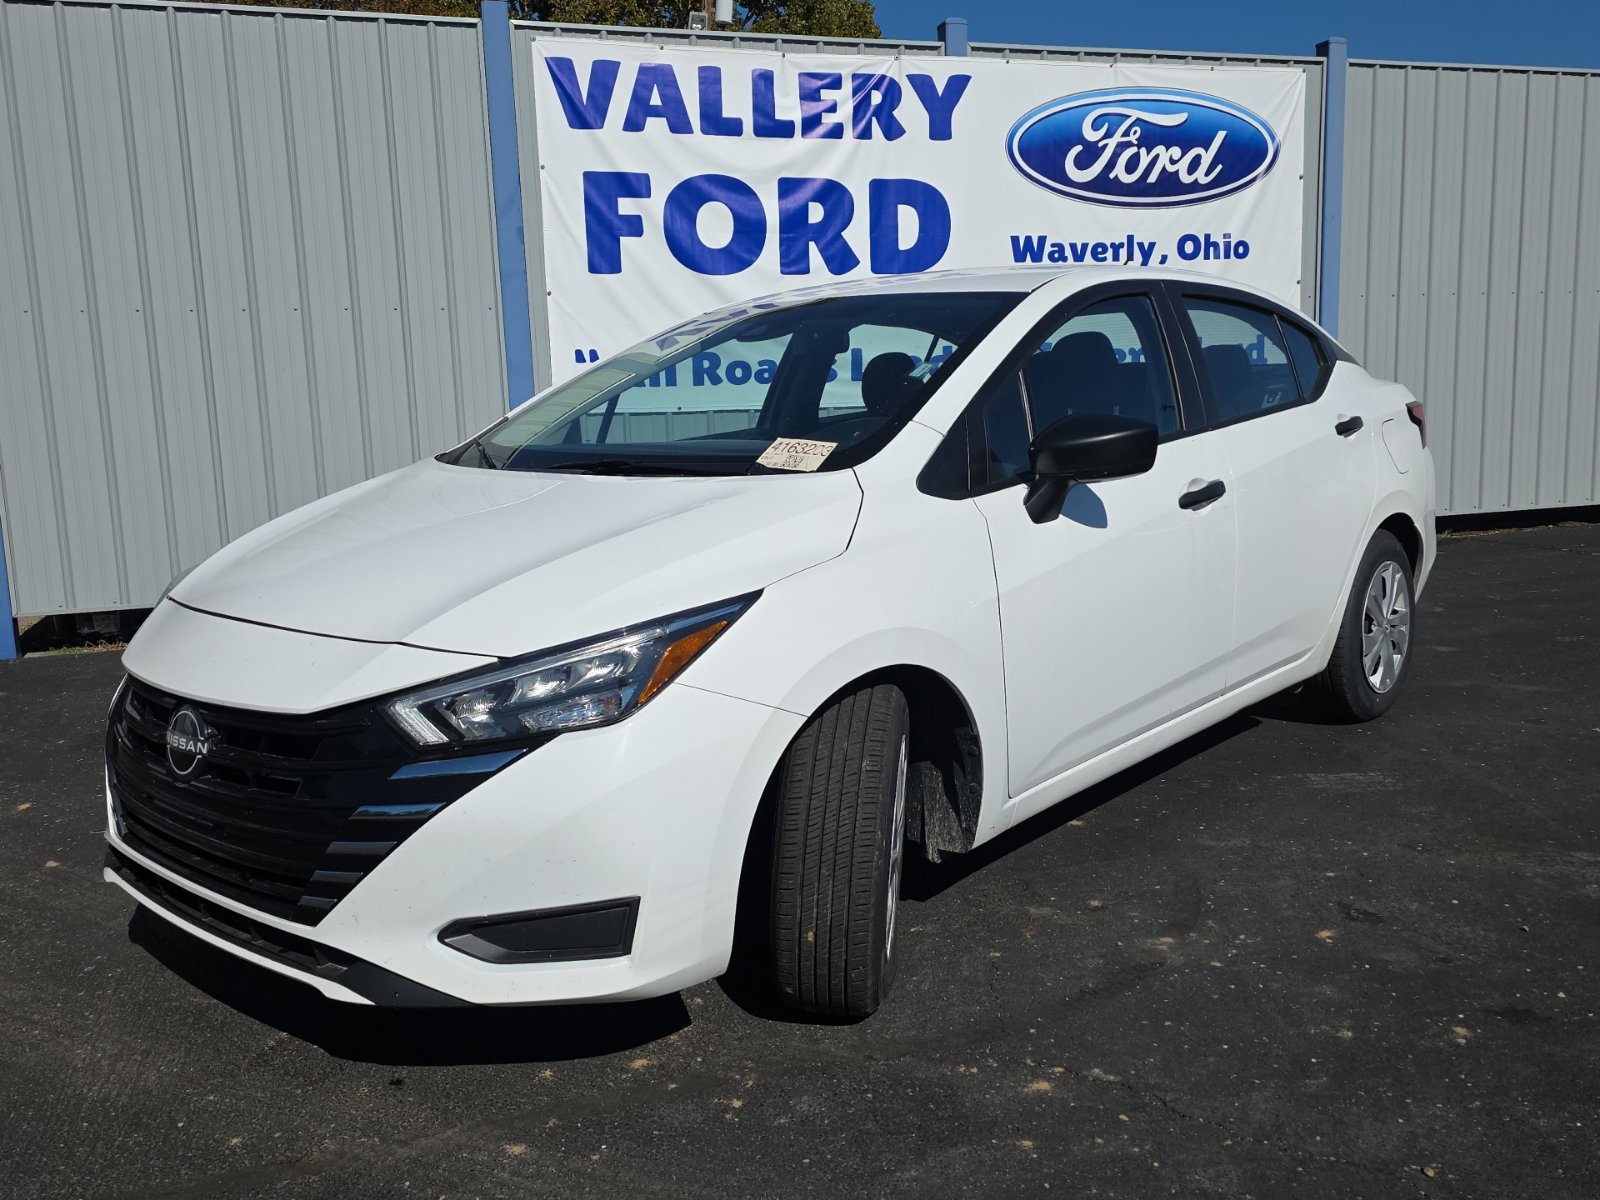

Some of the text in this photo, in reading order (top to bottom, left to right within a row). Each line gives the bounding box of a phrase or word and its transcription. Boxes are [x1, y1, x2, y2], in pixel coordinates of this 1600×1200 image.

[545, 56, 972, 142] VALLERY
[1065, 106, 1228, 185] Ford
[583, 170, 952, 276] FORD
[1010, 232, 1251, 268] Waverly, Ohio
[770, 441, 834, 457] 4163203
[166, 730, 208, 754] NISSAN
